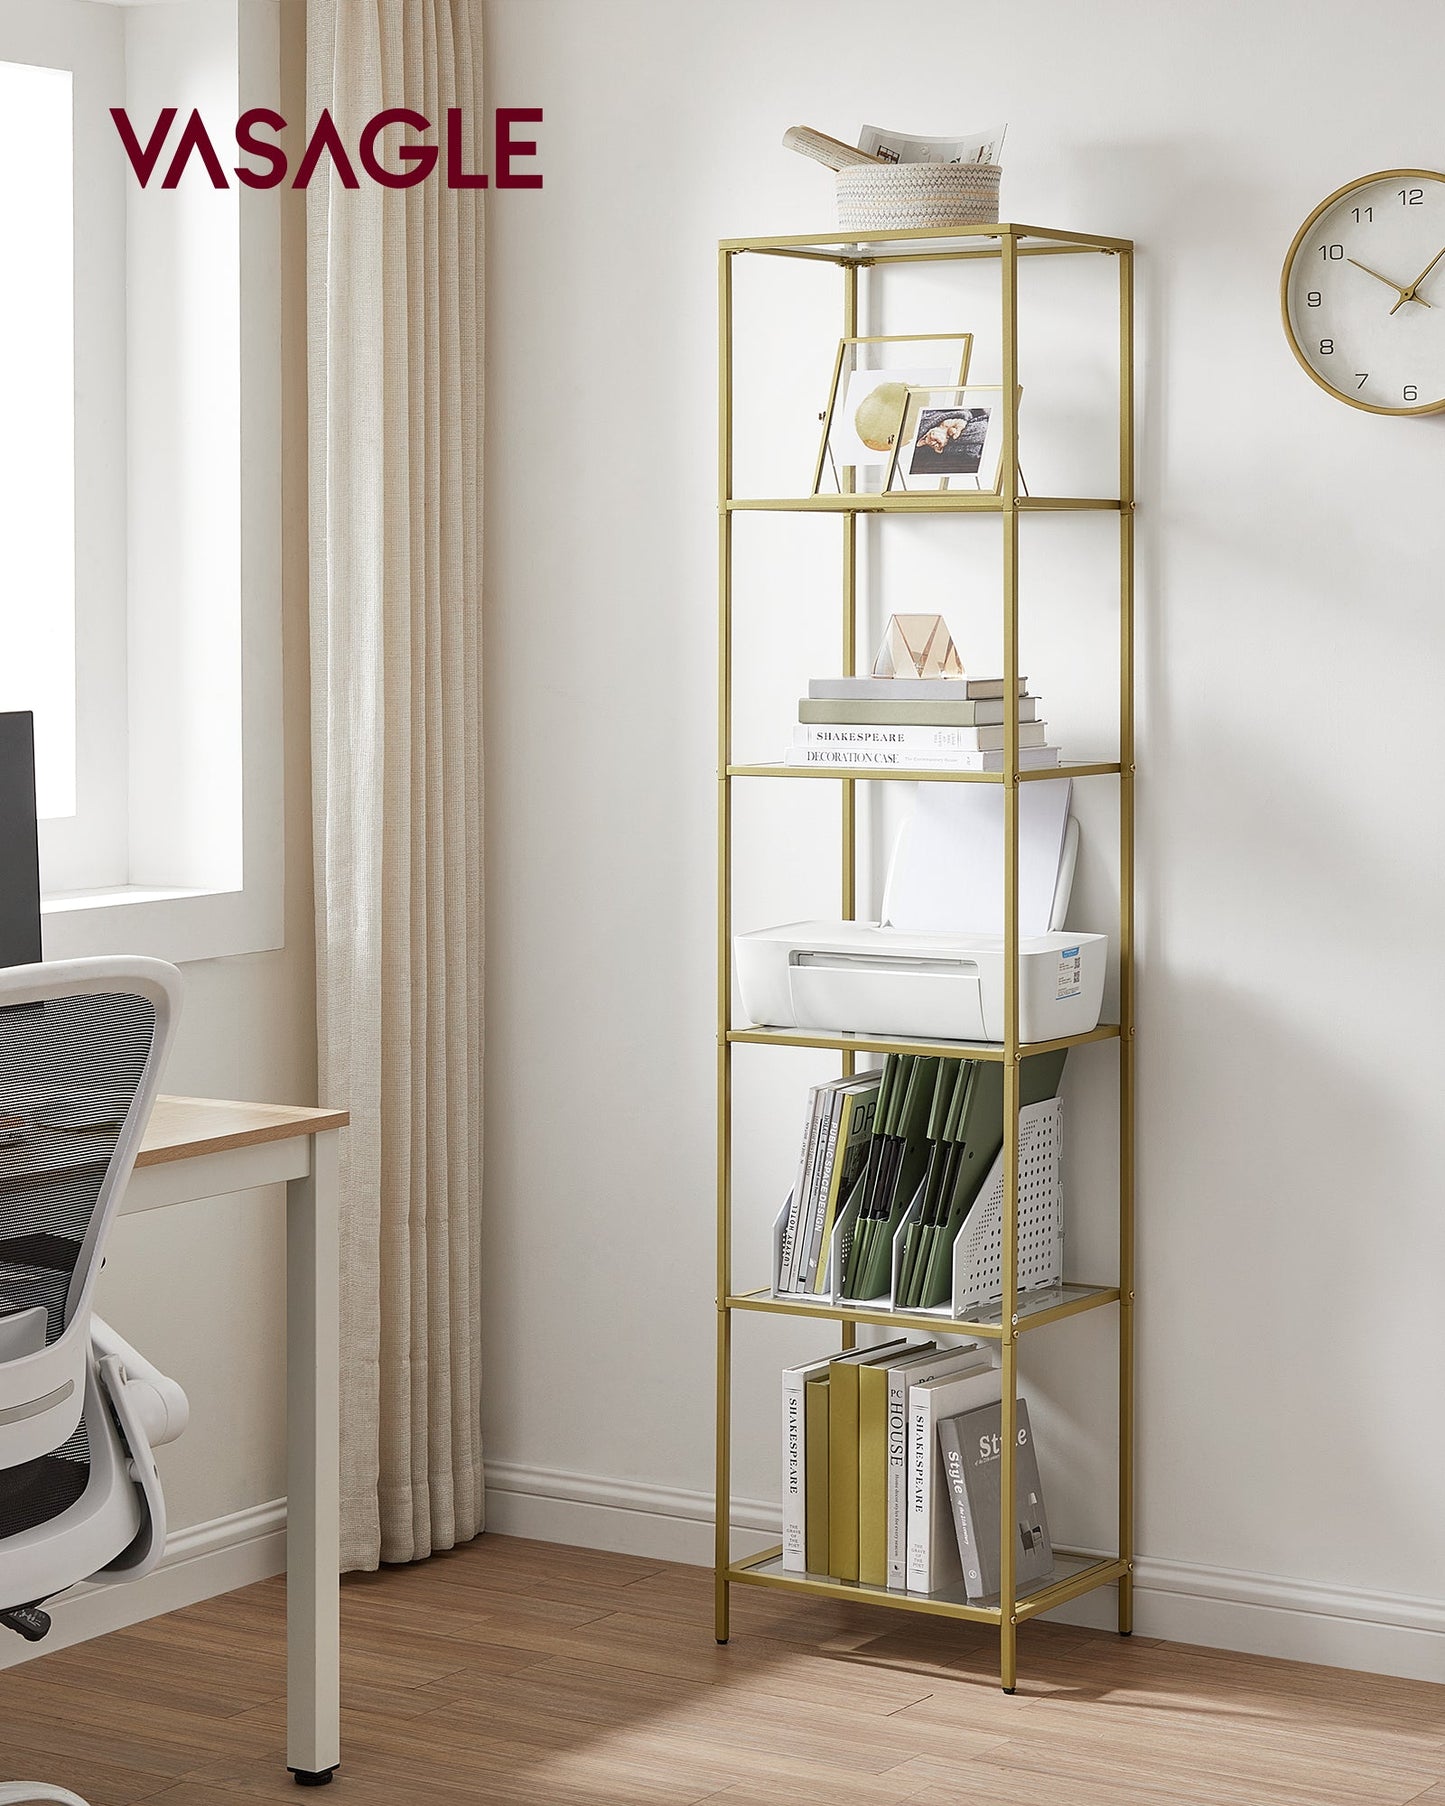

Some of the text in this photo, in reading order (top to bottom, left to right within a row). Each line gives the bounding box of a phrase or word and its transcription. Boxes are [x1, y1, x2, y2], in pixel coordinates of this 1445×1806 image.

[1397, 189, 1424, 206] 12
[1351, 207, 1373, 223] 11
[1318, 244, 1344, 261] 10
[1307, 291, 1321, 307] 9
[1319, 339, 1334, 355] 8
[1355, 373, 1369, 389] 7
[1403, 385, 1417, 401] 6
[816, 731, 905, 743] SHAKESPEARE
[807, 750, 872, 763] DECORATION
[874, 752, 899, 764] CASE
[826, 1121, 838, 1158] PUBLIC
[820, 1159, 832, 1192] SPACE
[789, 1205, 798, 1231] HOTEL
[814, 1194, 826, 1231] DESIGN
[890, 1389, 903, 1399] PC
[890, 1402, 903, 1467] HOUSE
[979, 1428, 1027, 1458] Ste
[789, 1398, 798, 1494] SHAKESPEARE
[916, 1415, 924, 1513] SHAKESPEARE
[948, 1451, 963, 1494] Style
